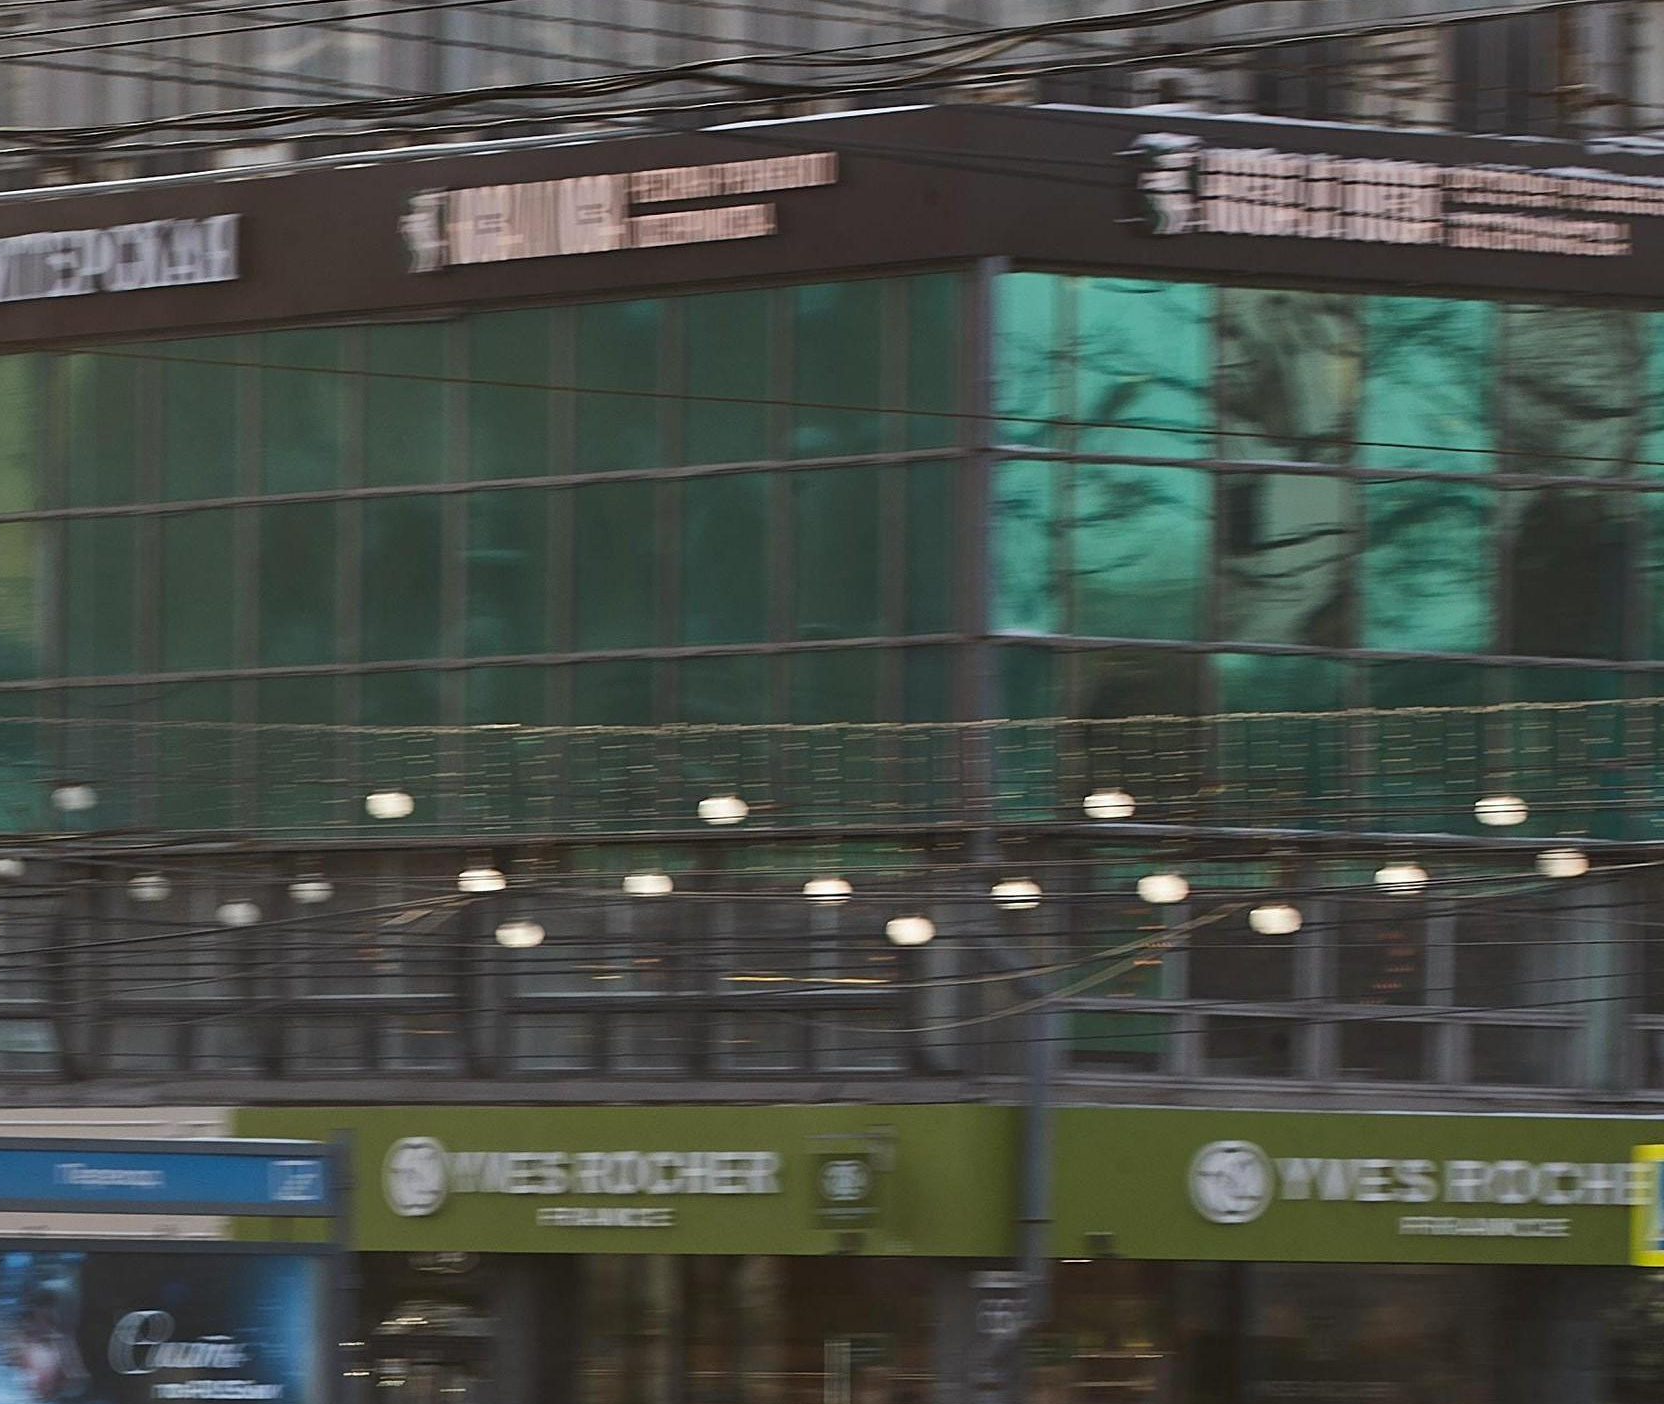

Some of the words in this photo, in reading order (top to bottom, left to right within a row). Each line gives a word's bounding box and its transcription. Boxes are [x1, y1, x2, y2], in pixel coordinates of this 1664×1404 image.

[452, 1151, 568, 1194] YVES
[572, 1151, 782, 1194] ROCHER
[1275, 1157, 1437, 1203] YVES
[1443, 1159, 1656, 1206] ROCHE
